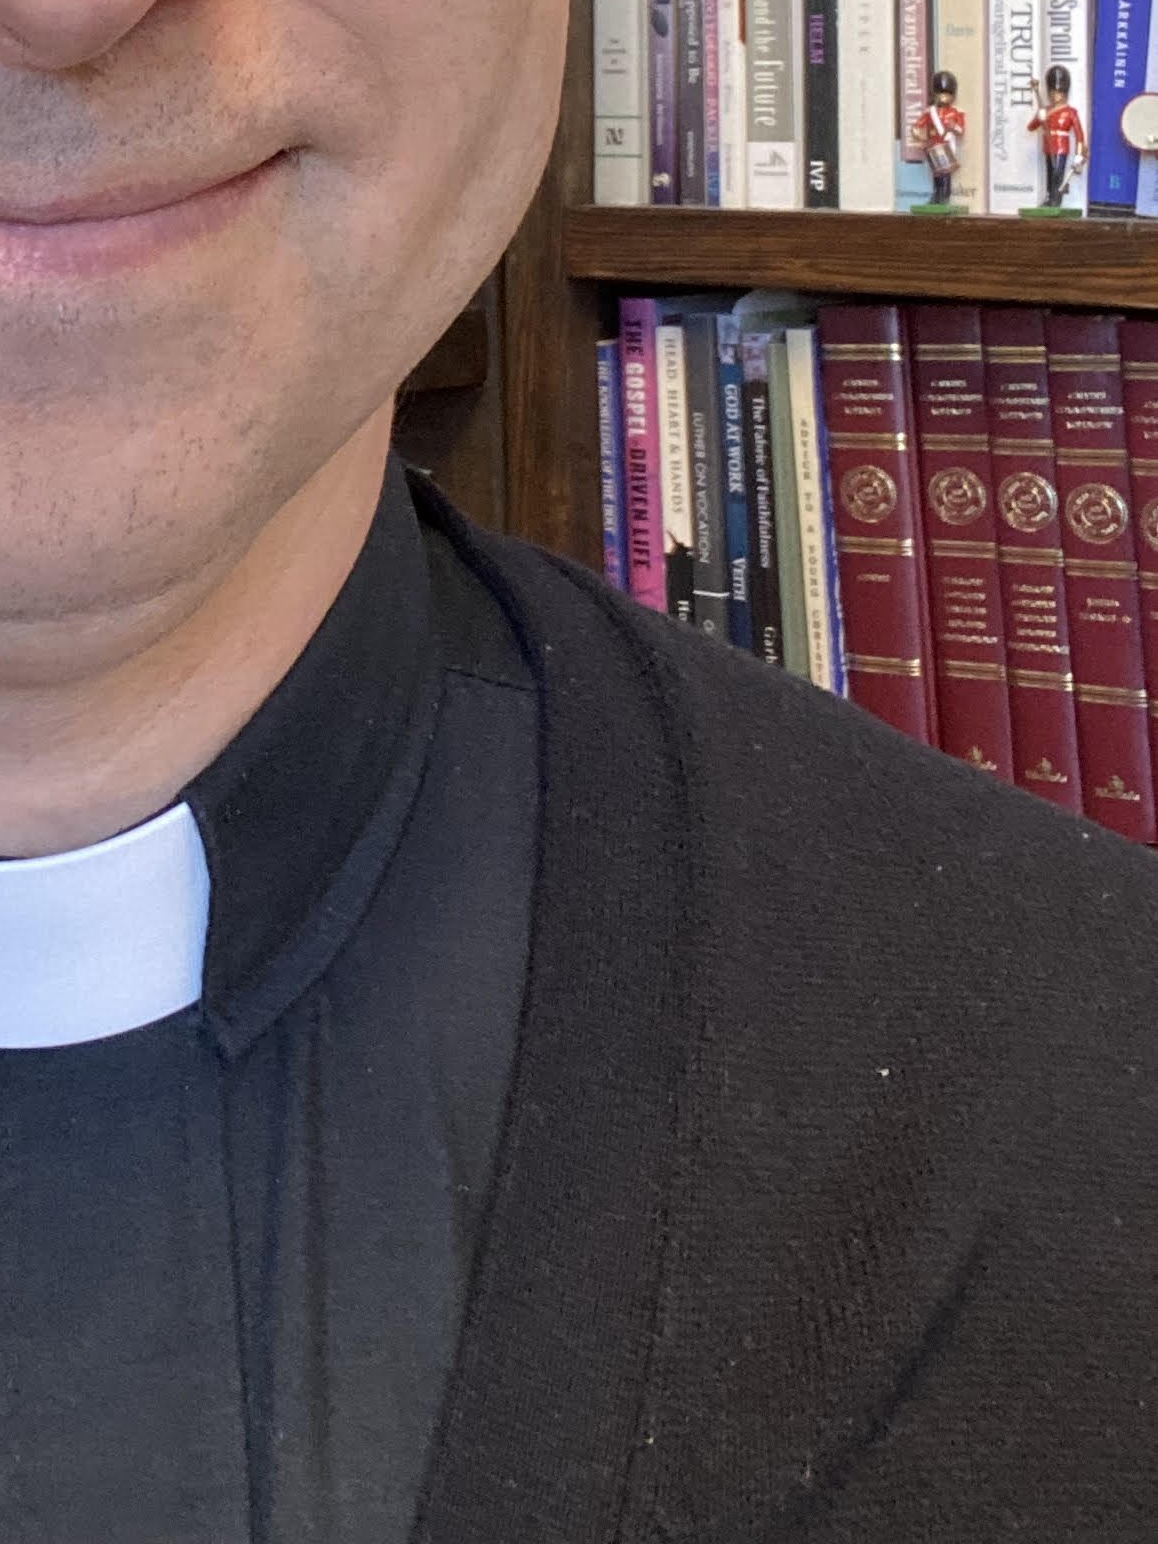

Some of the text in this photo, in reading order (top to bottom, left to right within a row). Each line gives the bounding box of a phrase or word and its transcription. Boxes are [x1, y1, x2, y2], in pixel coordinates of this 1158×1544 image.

[754, 29, 774, 54] the
[809, 13, 825, 65] HELM
[1010, 3, 1034, 108] TRUTH
[753, 59, 784, 127] Future
[992, 80, 1009, 163] Theology?
[810, 160, 827, 192] IVP
[666, 389, 681, 439] HEART
[724, 383, 744, 494] GOD AT WORK
[669, 443, 681, 454] &
[669, 459, 684, 514] HANDS
[691, 411, 712, 564] LUTHER ON VOCATION
[751, 396, 773, 569] The Fabric of Faithfulness
[633, 526, 652, 569] LIFE
[731, 557, 747, 602] VEITH
